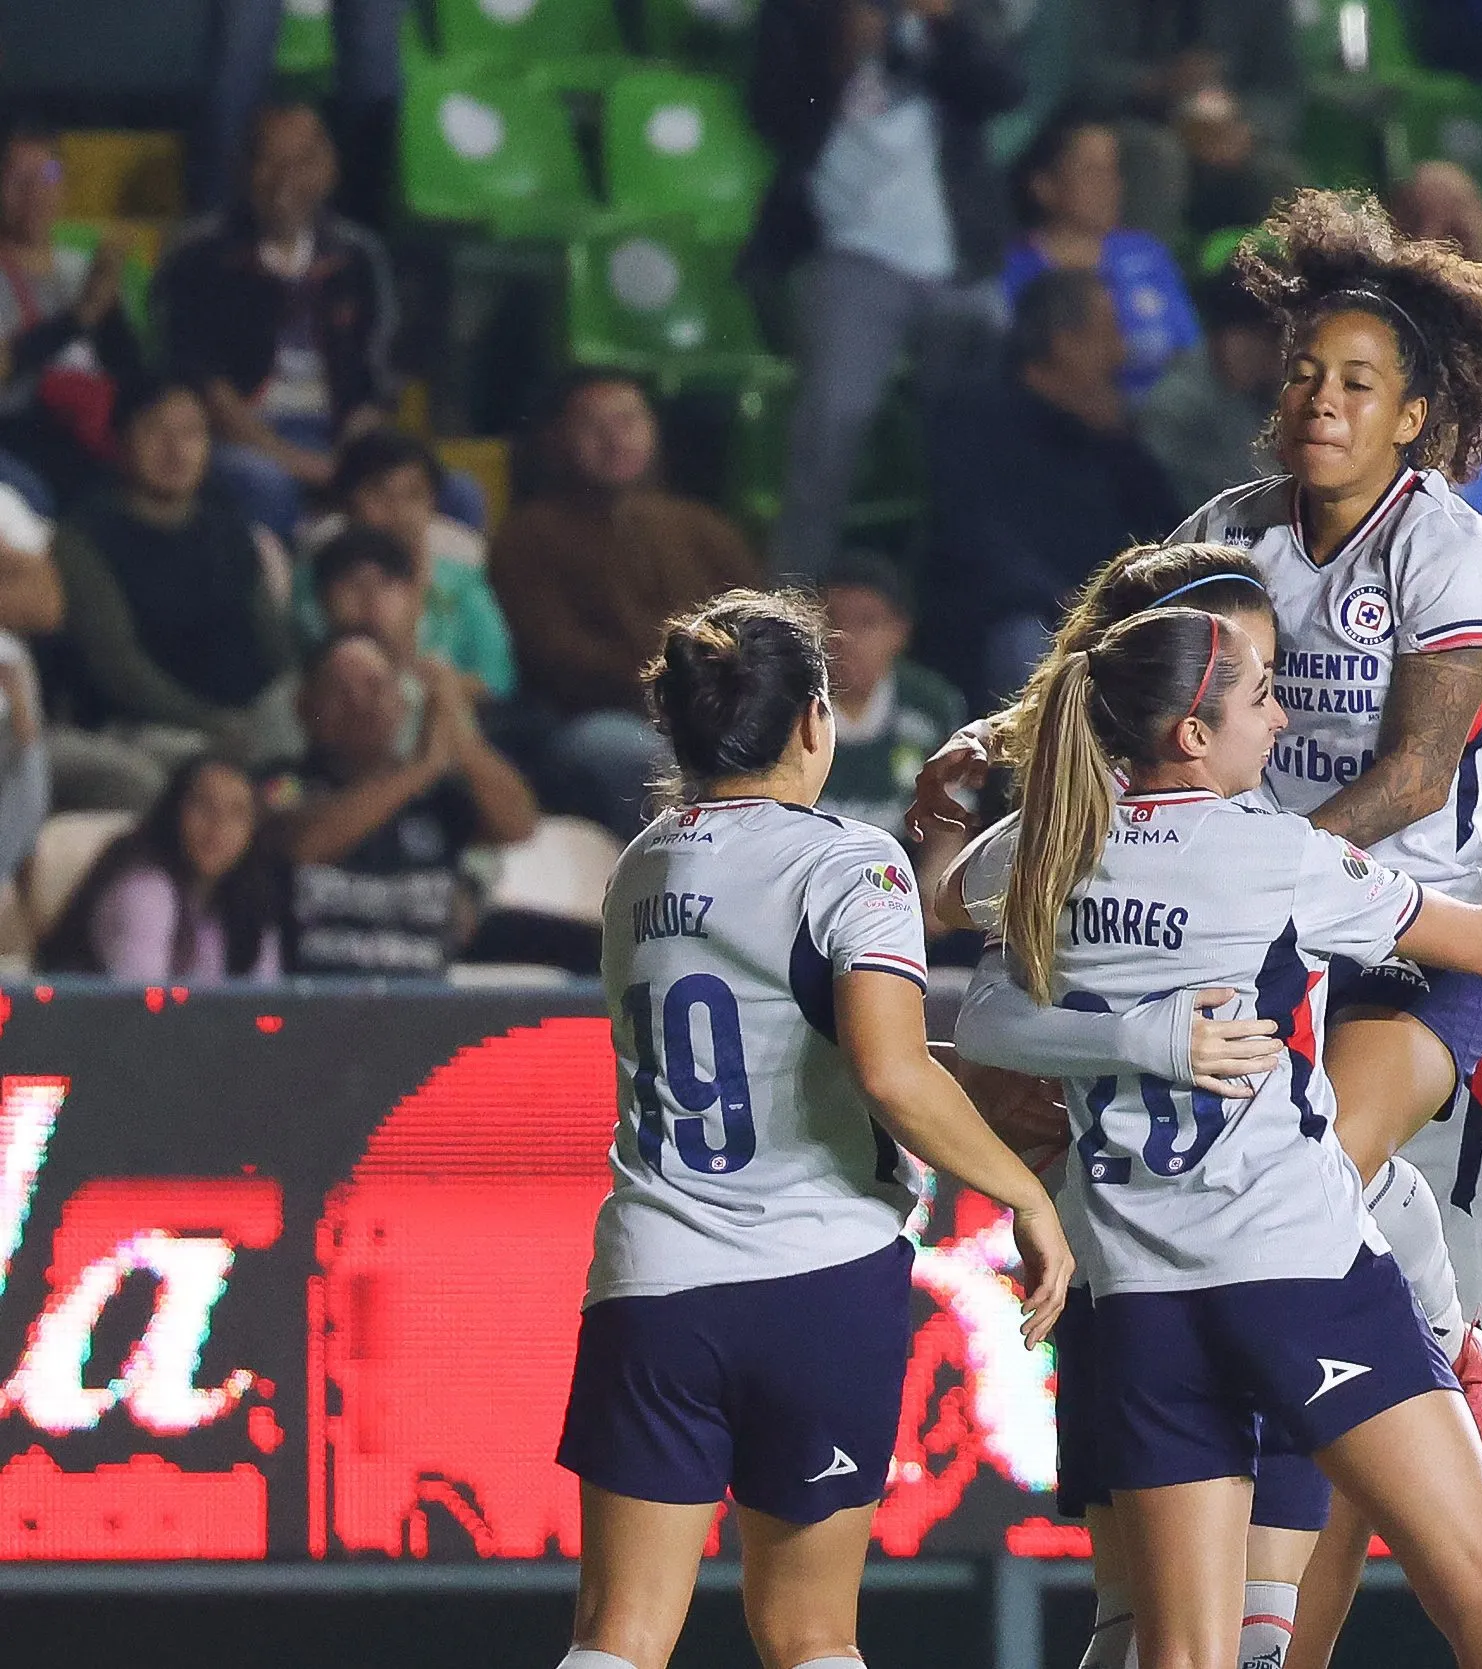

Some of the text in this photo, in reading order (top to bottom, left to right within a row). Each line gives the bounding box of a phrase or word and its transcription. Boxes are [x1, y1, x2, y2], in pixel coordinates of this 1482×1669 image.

[1275, 651, 1379, 681] EMENTO
[1274, 684, 1380, 714] RUZ AZUL
[1268, 736, 1374, 786] vibe
[632, 891, 714, 944] VALDEZ
[1065, 896, 1189, 951] TORRES
[1360, 967, 1431, 993] PIRMA
[620, 973, 756, 1175] 19
